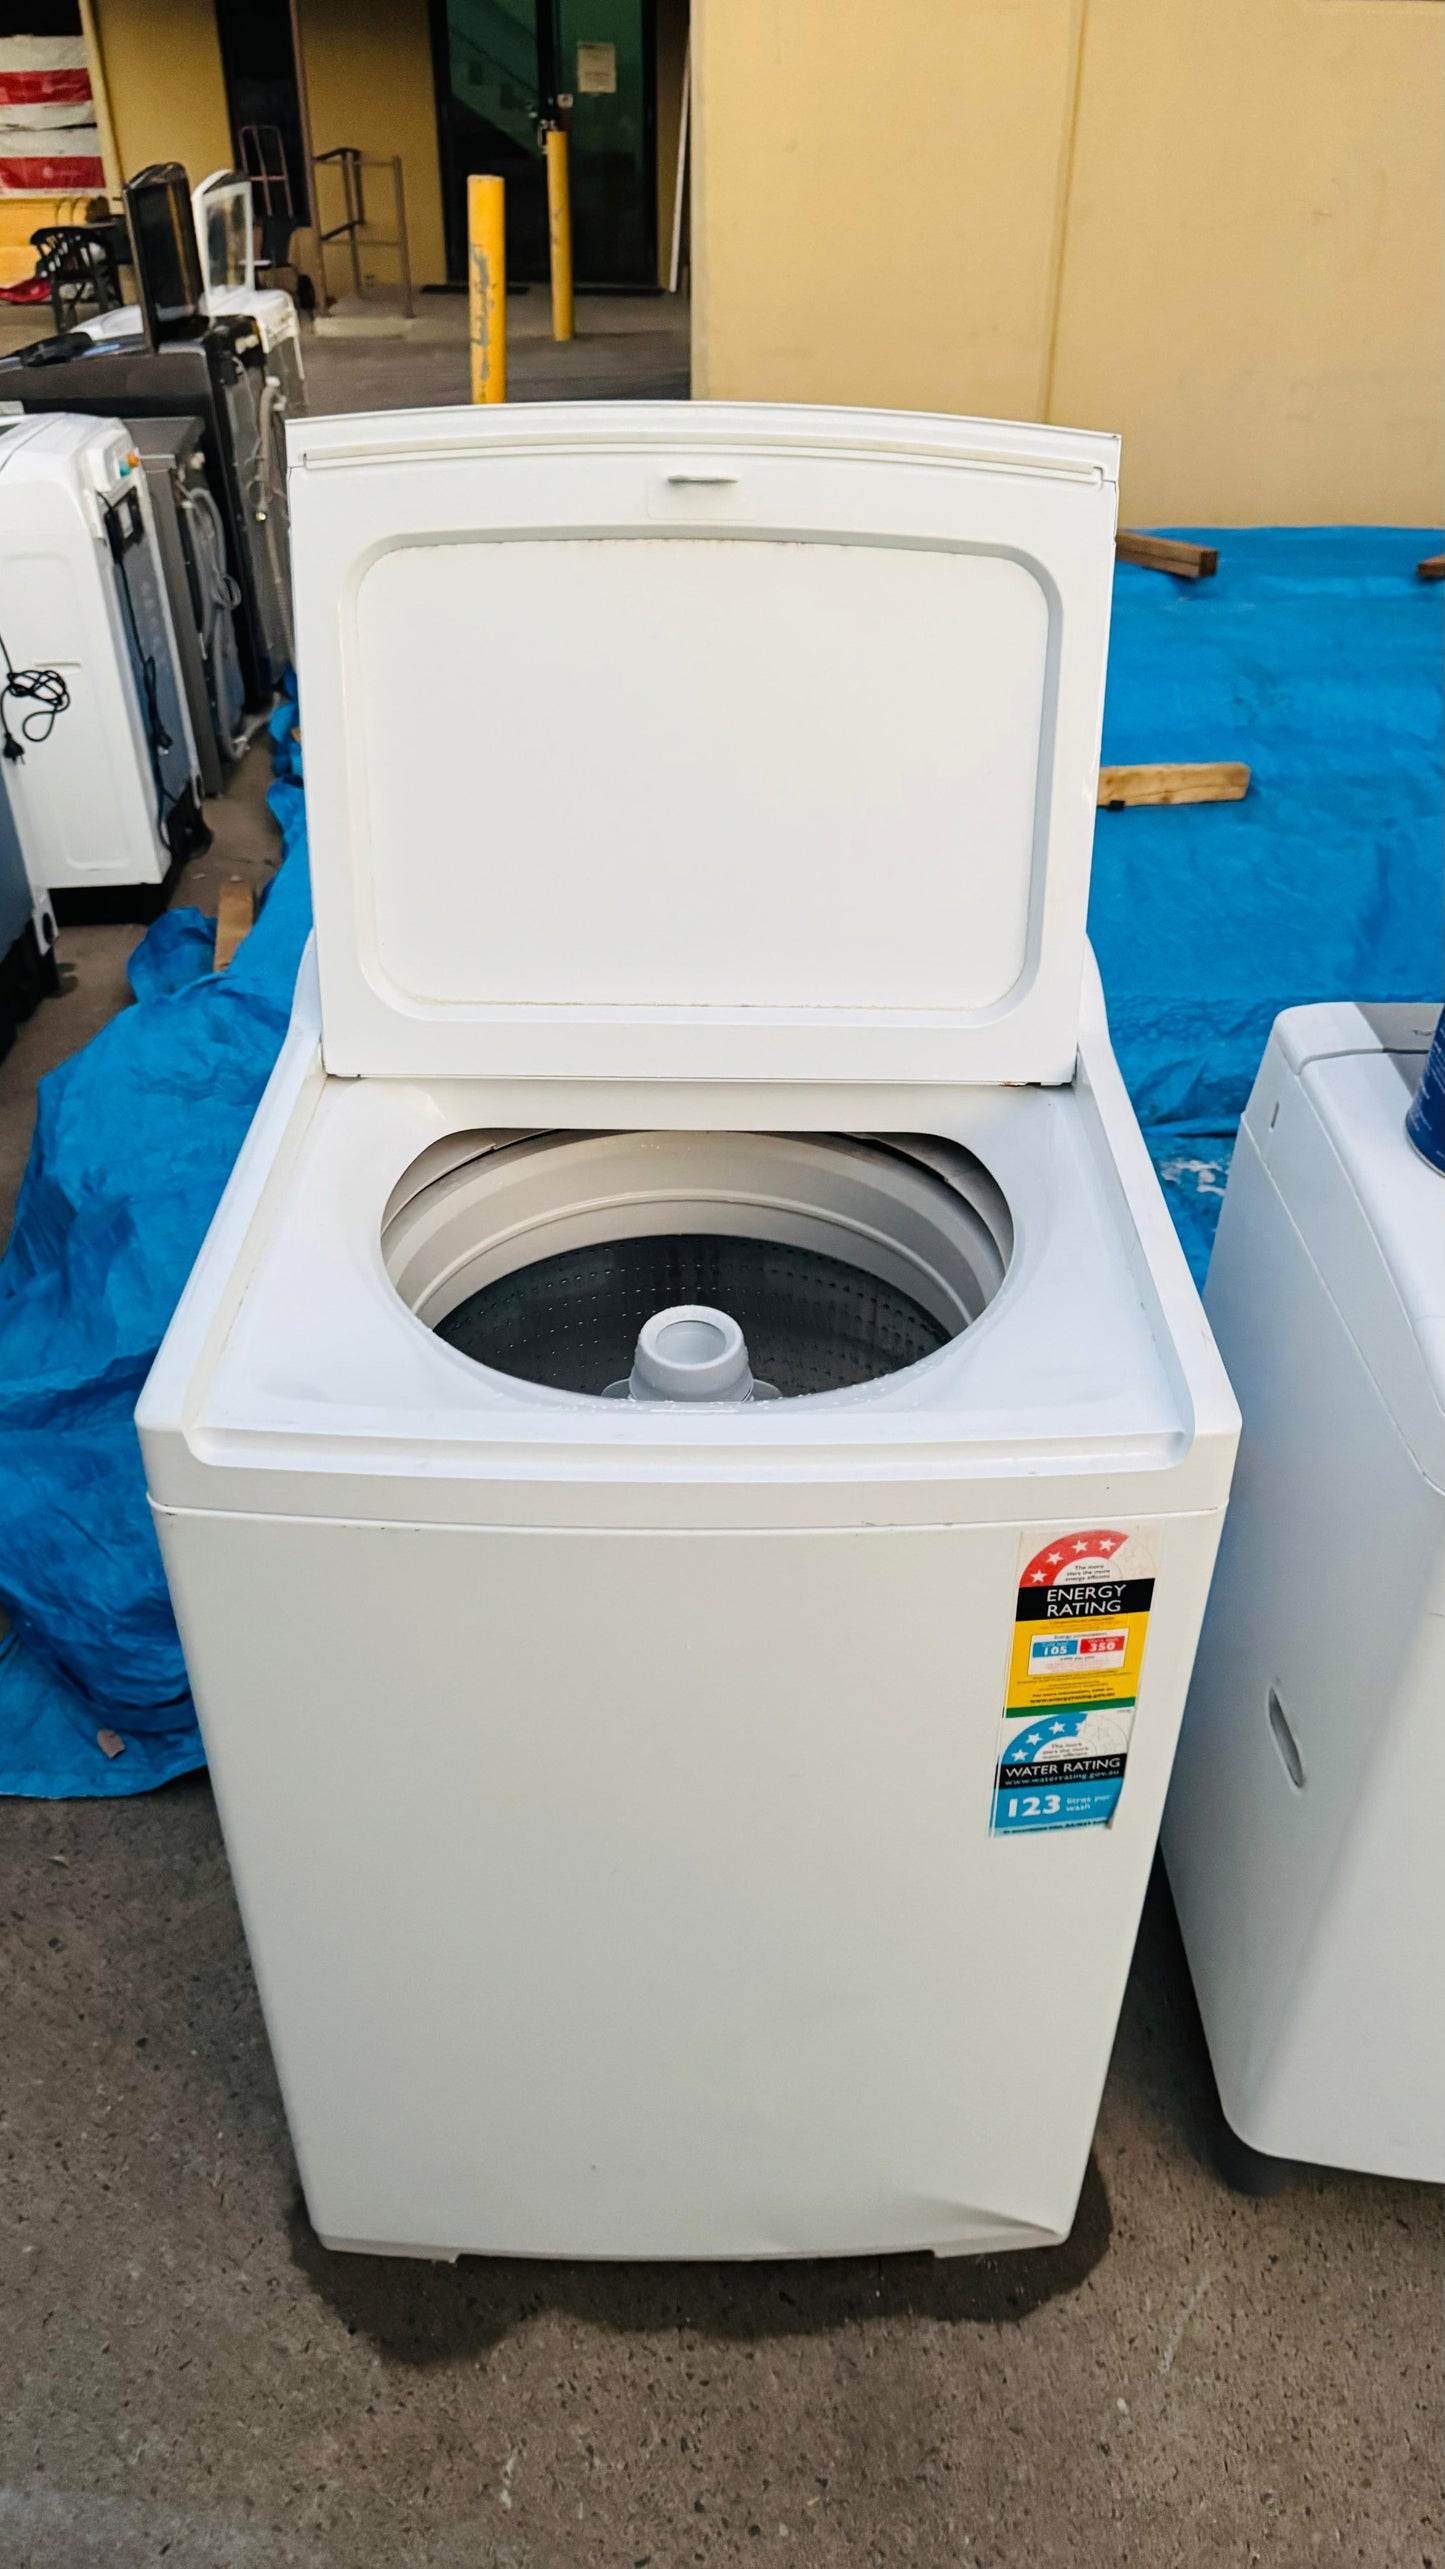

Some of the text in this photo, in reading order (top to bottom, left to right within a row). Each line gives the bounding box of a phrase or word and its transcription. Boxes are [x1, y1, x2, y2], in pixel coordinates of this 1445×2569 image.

[1046, 1583, 1127, 1602] ENERGY
[1046, 1600, 1121, 1617] RATING
[1043, 1642, 1116, 1656] 105 350
[1006, 1757, 1121, 1778] WATER RATING
[1004, 1769, 1120, 1786] www.waterrating.gov.au
[1008, 1794, 1061, 1818] 123
[1066, 1803, 1091, 1812] wash
